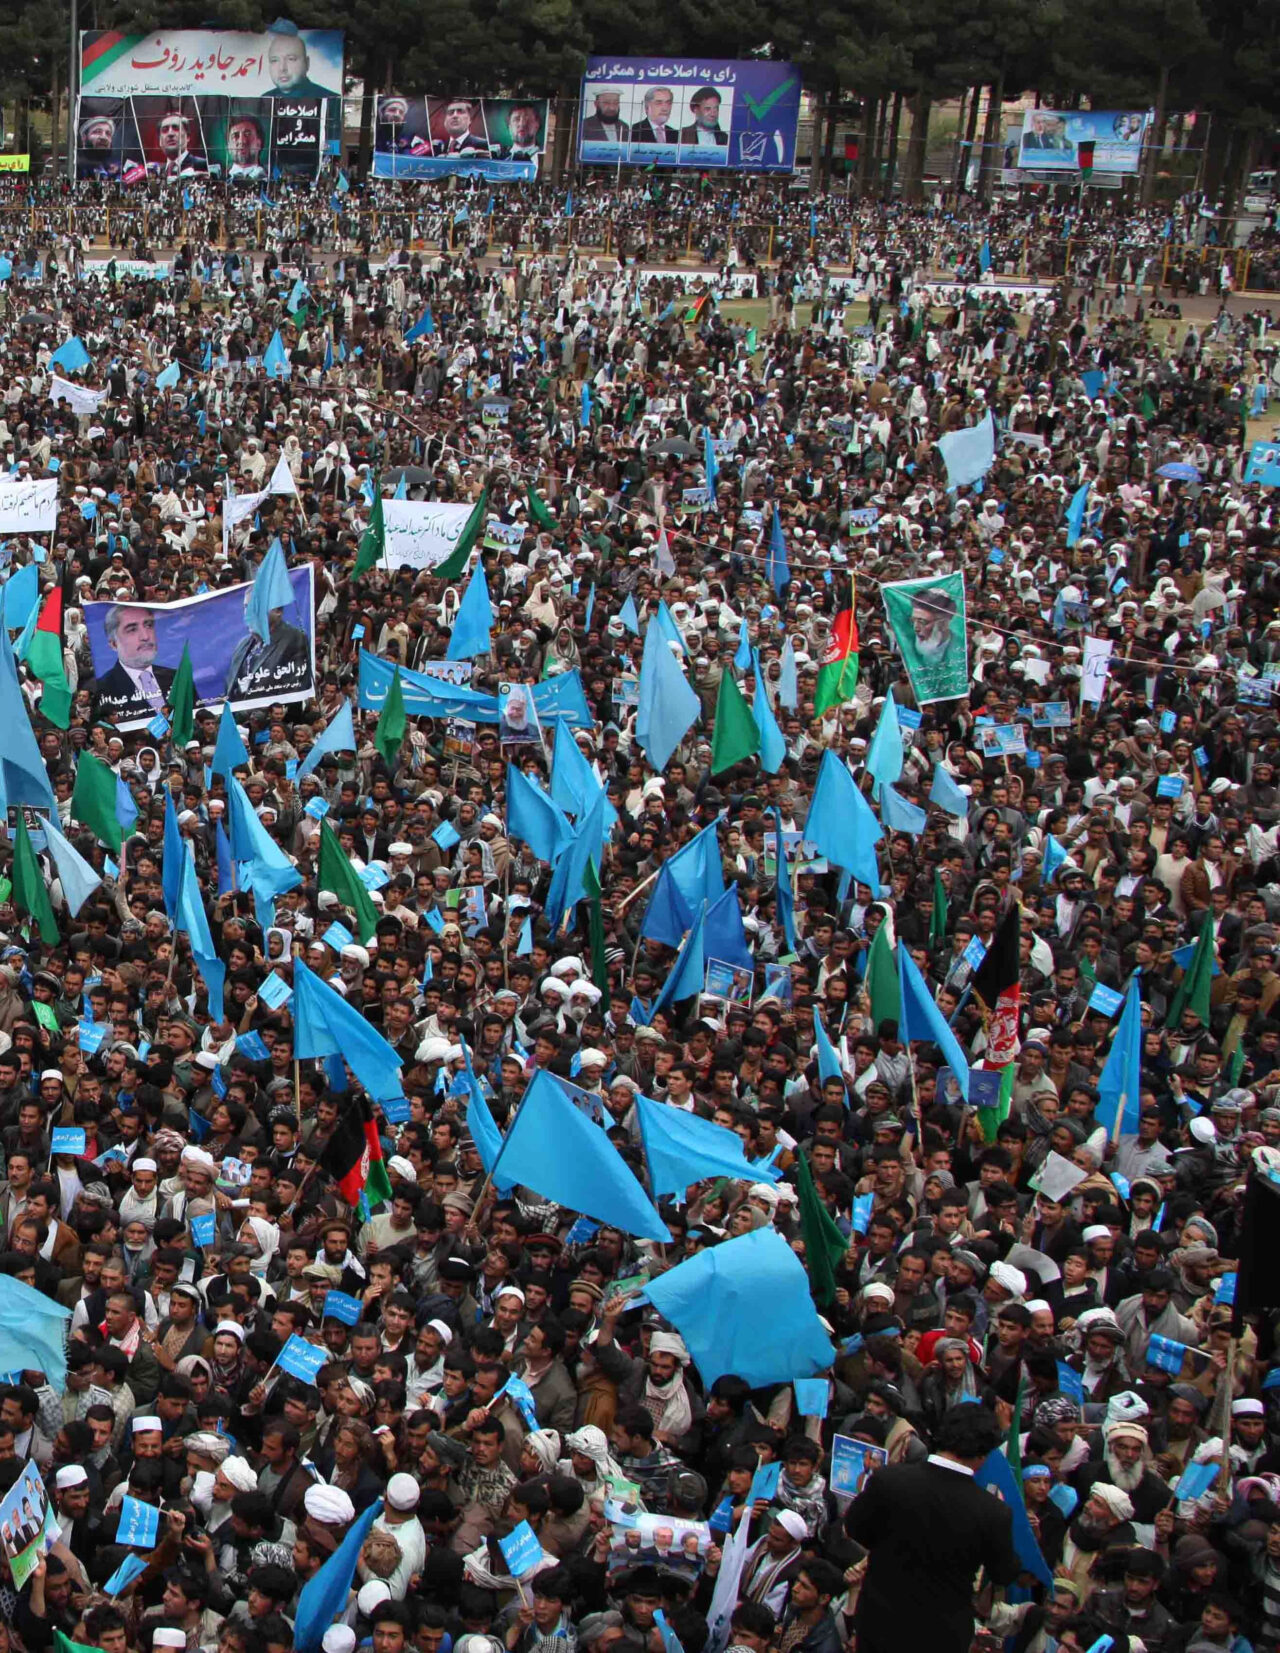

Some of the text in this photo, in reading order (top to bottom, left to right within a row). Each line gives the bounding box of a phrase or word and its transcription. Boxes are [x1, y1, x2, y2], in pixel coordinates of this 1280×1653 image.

[131, 38, 263, 80] احمد جاوید رؤف
[586, 64, 635, 80] همگرایی
[638, 69, 645, 80] و
[647, 65, 697, 79] اصلاحات
[699, 67, 711, 81] به
[117, 83, 139, 93] شورای
[276, 105, 318, 117] اصلاحات
[295, 120, 303, 131] و
[276, 132, 316, 146] همگرایی
[237, 666, 271, 685] علومی
[130, 689, 163, 702] عبدالله
